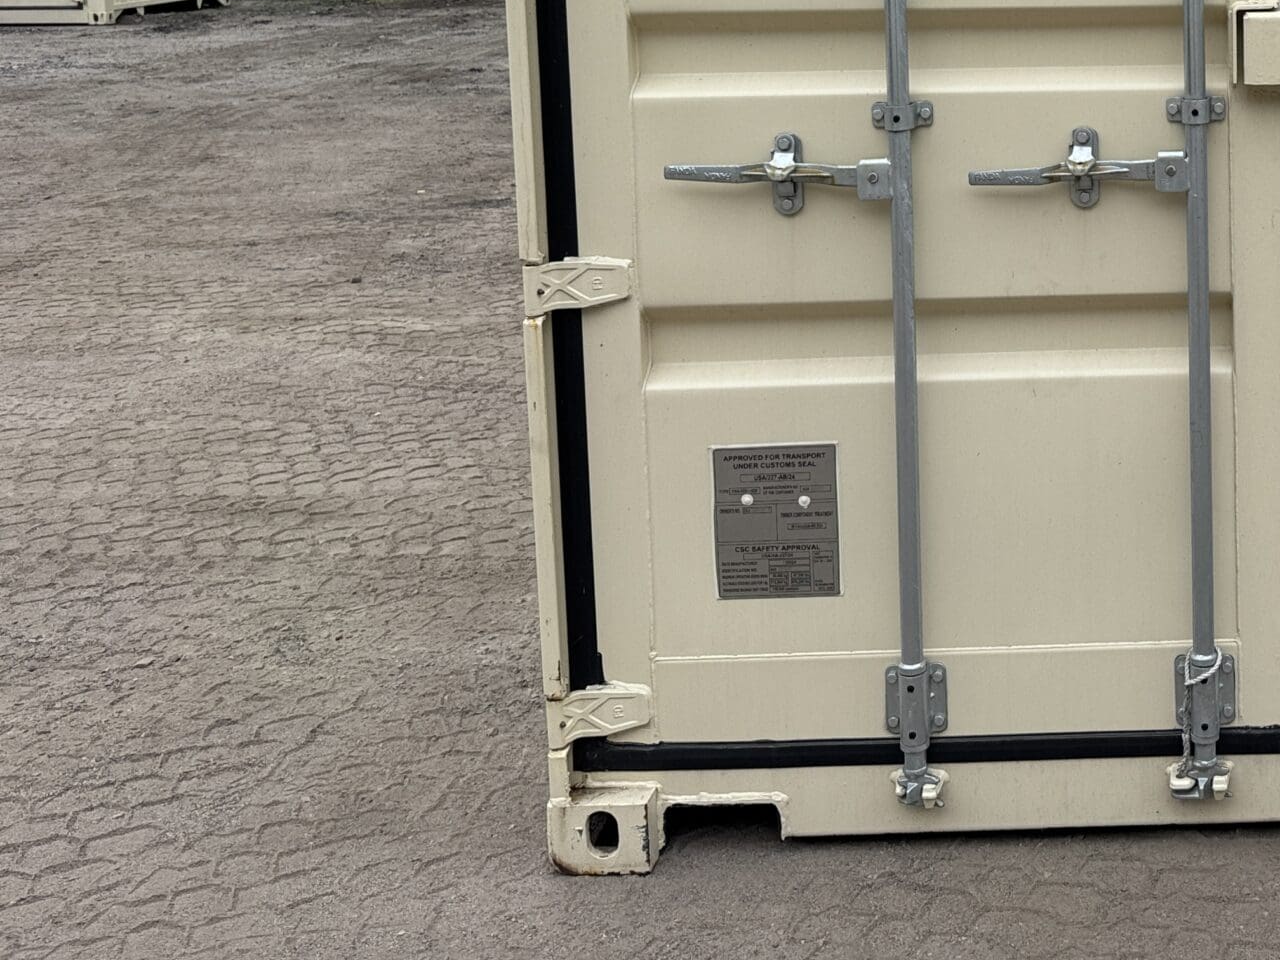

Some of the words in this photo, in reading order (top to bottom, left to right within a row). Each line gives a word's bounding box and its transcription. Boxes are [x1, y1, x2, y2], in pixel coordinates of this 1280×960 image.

[723, 454, 764, 462] APPROVED
[782, 452, 826, 460] TRANSPORT
[732, 462, 759, 470] UNDER
[760, 461, 796, 469] CUSTOMS
